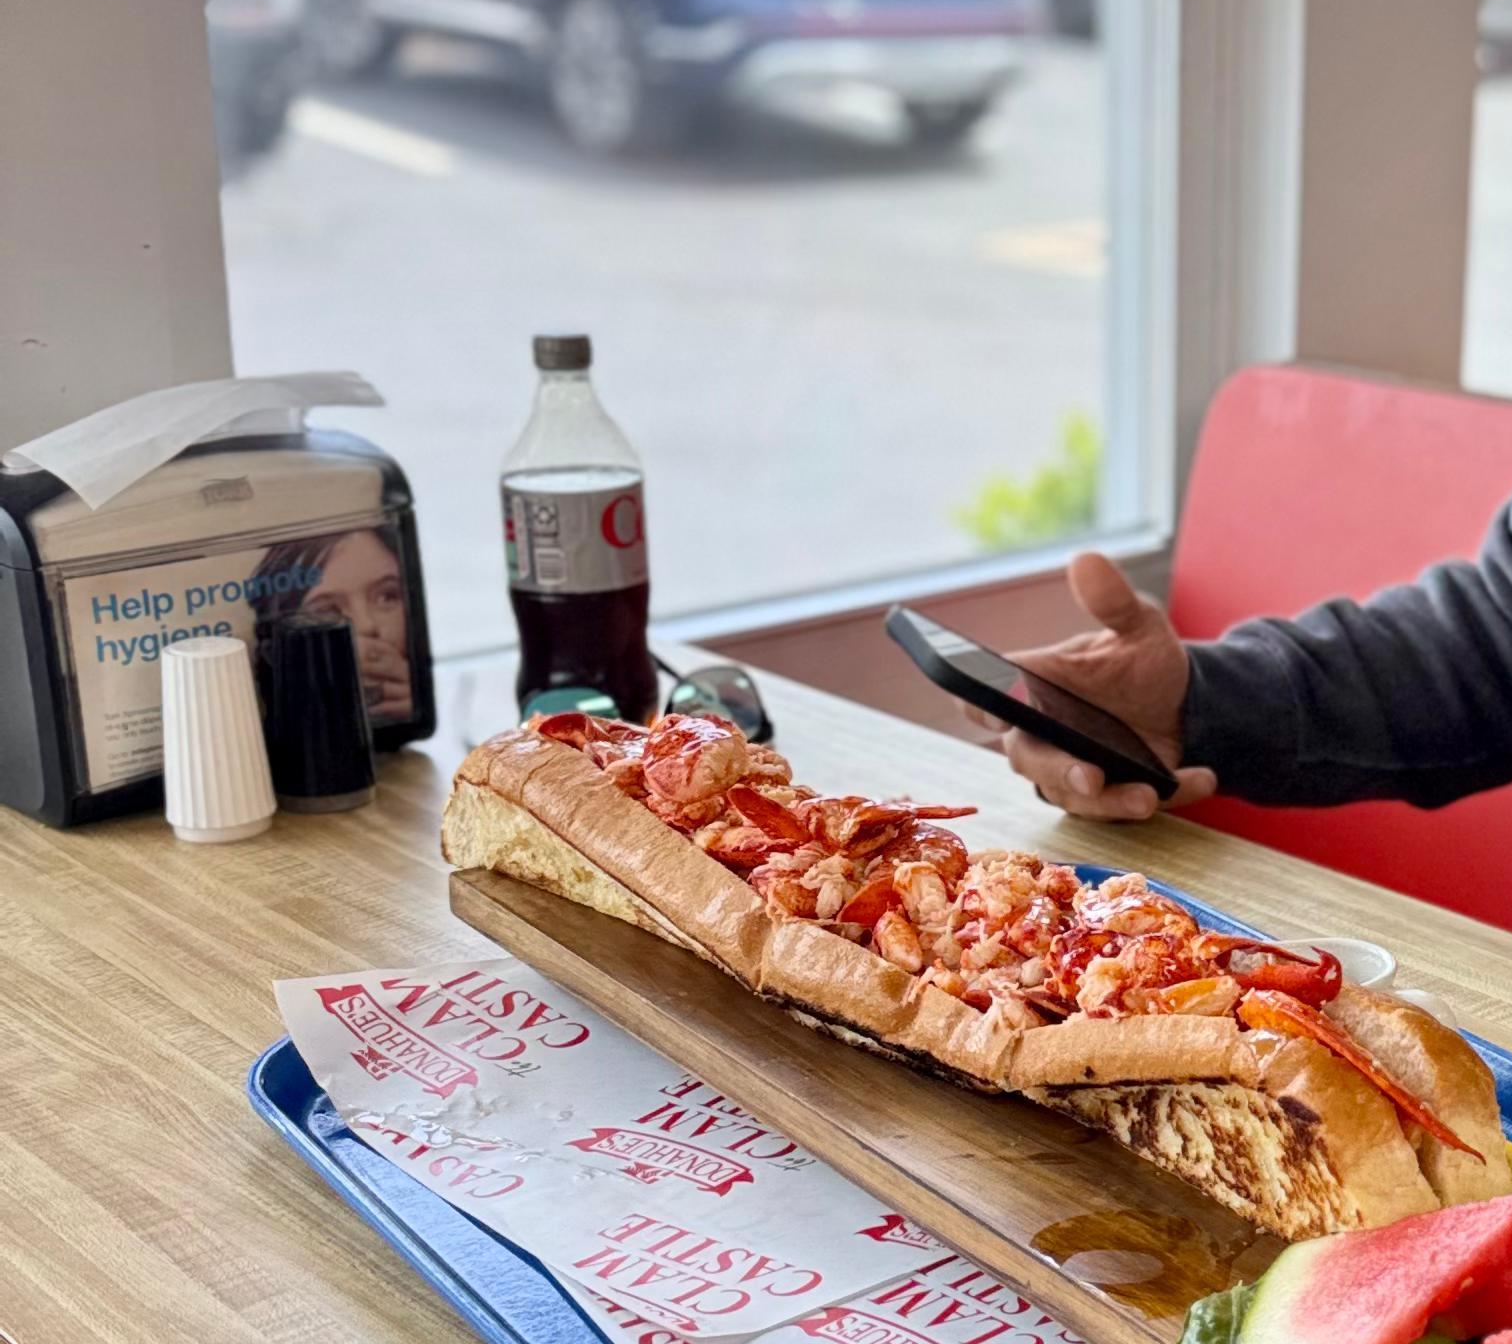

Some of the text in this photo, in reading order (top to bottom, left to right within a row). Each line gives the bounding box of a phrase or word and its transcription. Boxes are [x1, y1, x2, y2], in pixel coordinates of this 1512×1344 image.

[92, 563, 323, 624] Help promote
[338, 996, 466, 1084] DONAHUE'S
[597, 1133, 738, 1183] DONAHUE'S
[631, 1102, 798, 1159] CLAM
[572, 1246, 751, 1315] CLAM
[597, 1213, 823, 1296] CASTLE
